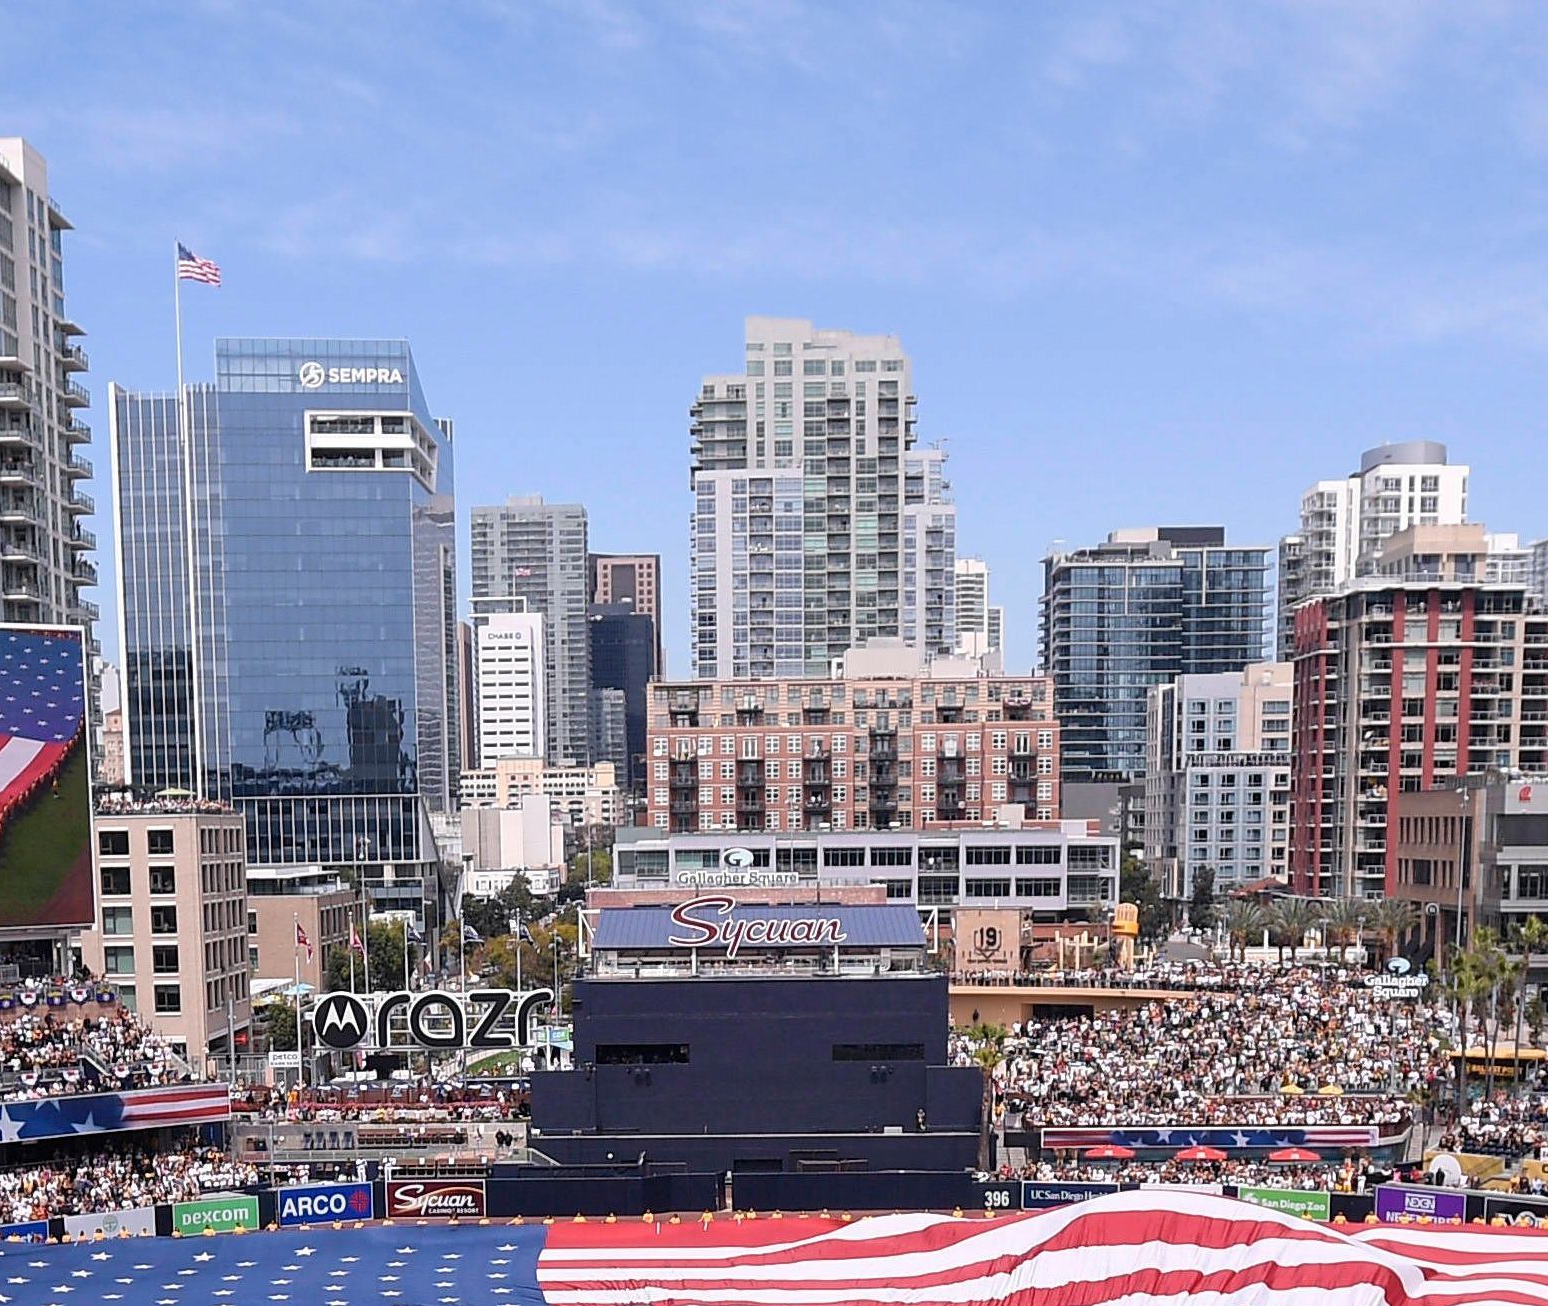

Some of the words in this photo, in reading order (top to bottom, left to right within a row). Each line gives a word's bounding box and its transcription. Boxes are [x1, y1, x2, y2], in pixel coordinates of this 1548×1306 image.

[329, 368, 403, 384] SEMPRA
[488, 632, 513, 640] CHASE
[678, 871, 747, 885] Gallagher
[749, 871, 798, 885] Square
[668, 894, 847, 959] Sycuan
[980, 927, 997, 946] 19
[1364, 974, 1429, 987] Gallagher
[1373, 986, 1418, 998] Square
[375, 989, 554, 1048] razr
[394, 1184, 476, 1215] Sycuan
[984, 1190, 1010, 1208] 396
[1031, 1189, 1042, 1200] UC
[281, 1193, 346, 1218] ARCO
[1261, 1198, 1278, 1209] San
[1279, 1200, 1306, 1212] Diego
[1307, 1202, 1326, 1212] Zoo
